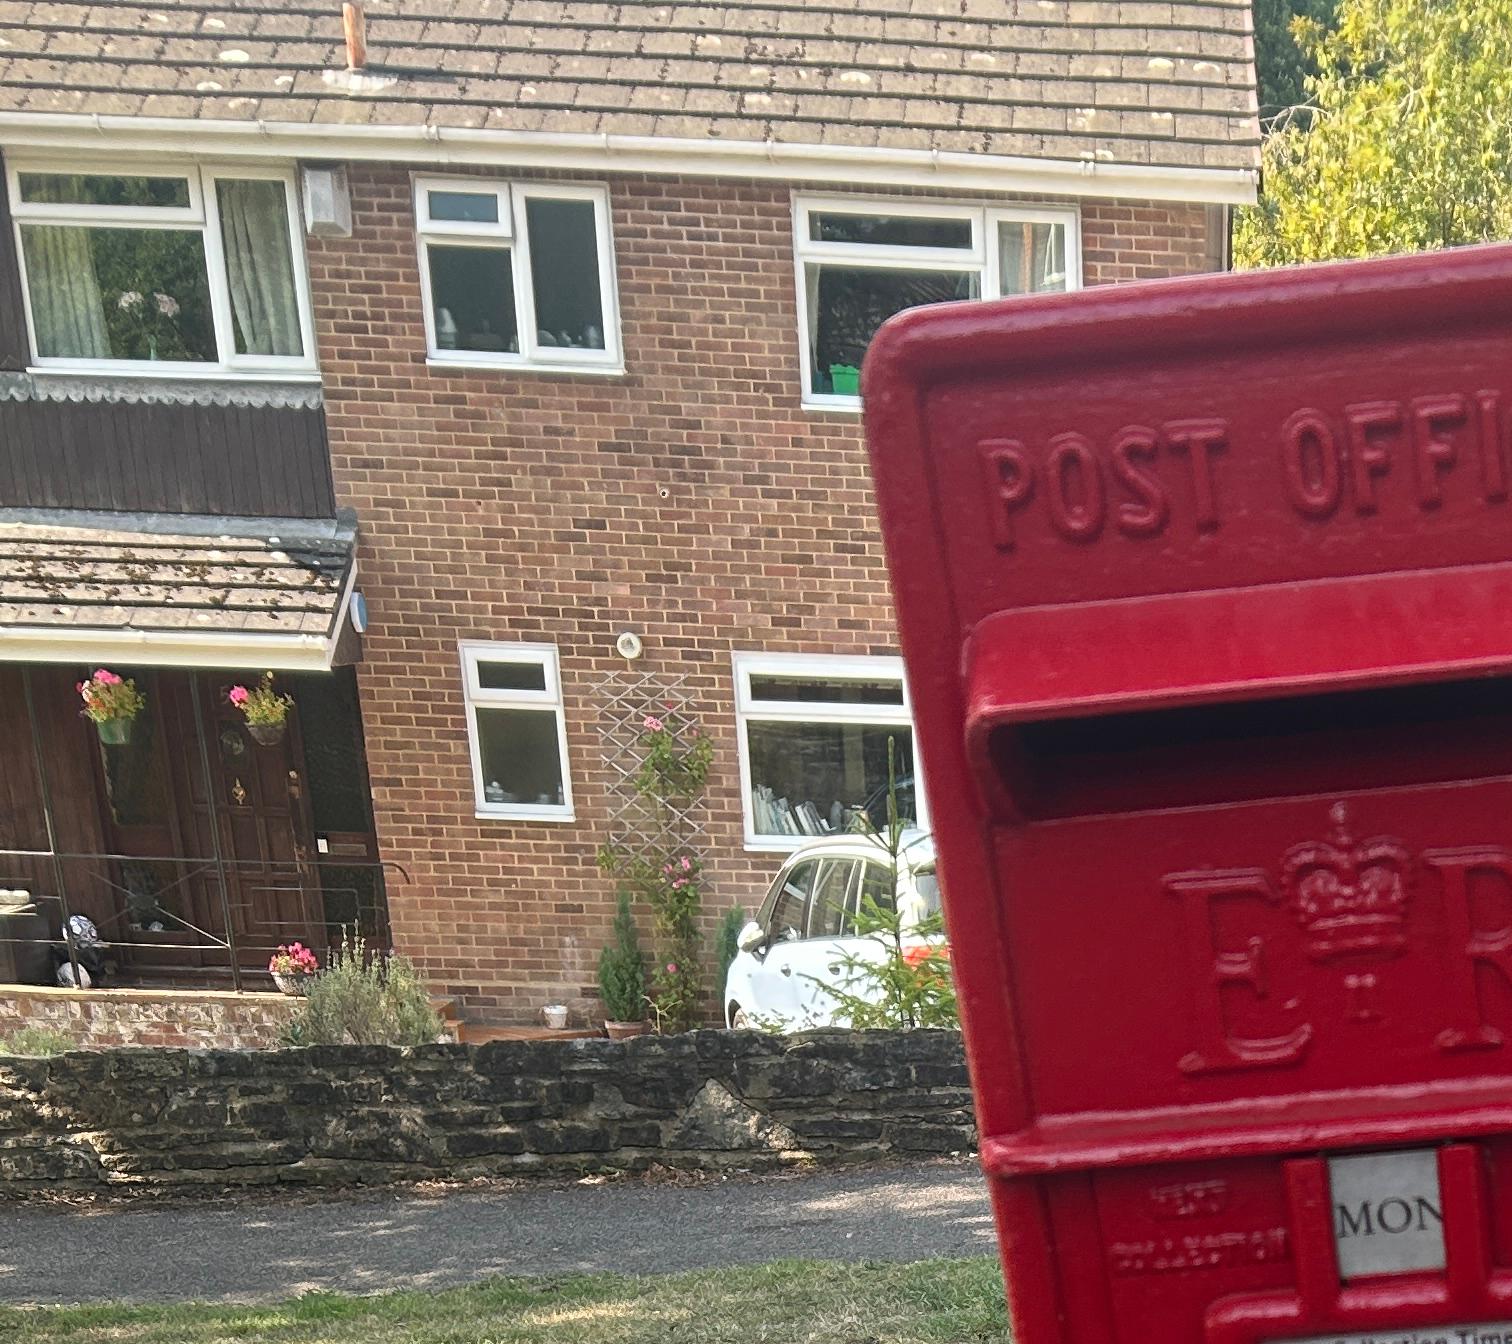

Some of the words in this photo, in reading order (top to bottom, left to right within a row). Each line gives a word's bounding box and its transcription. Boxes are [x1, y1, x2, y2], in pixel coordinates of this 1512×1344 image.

[976, 417, 1231, 551] POST
[1162, 865, 1313, 1076] E
[1337, 1196, 1444, 1239] MON
